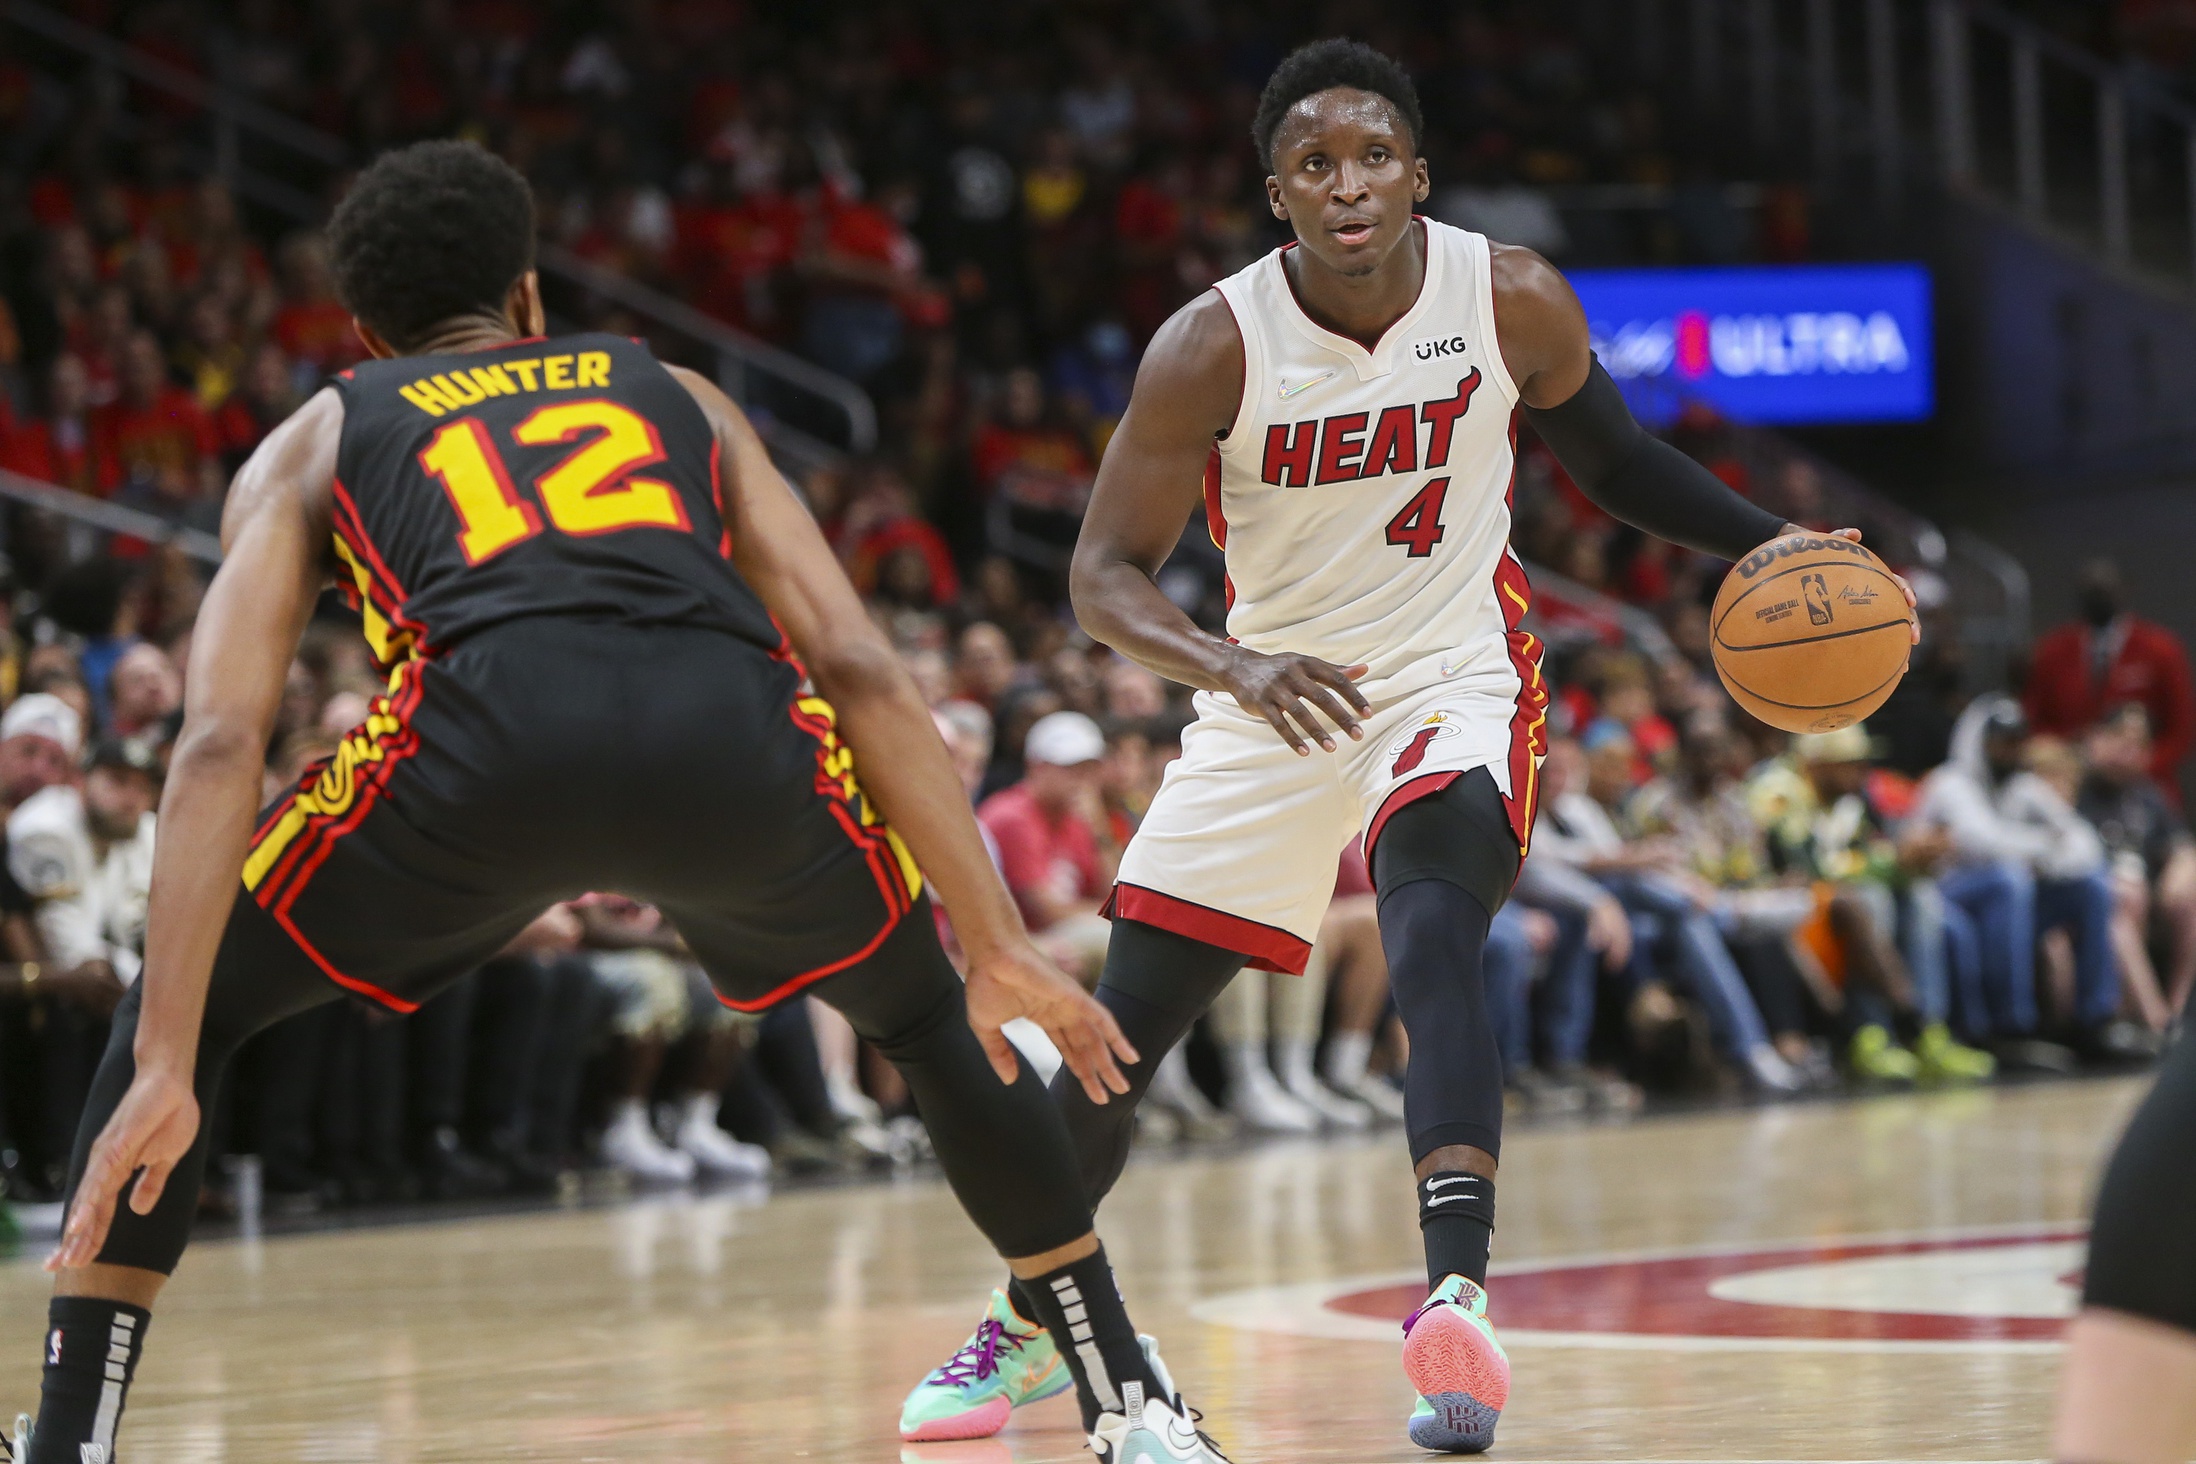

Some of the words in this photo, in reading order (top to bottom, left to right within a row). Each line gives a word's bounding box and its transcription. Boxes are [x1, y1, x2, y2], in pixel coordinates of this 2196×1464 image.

[1709, 312, 1909, 377] ULTRA
[399, 351, 611, 417] HUNTER
[1261, 365, 1482, 488] HEAT
[417, 397, 694, 567] 12
[1385, 476, 1451, 558] 4
[1736, 536, 1873, 580] Wilson
[1787, 599, 1799, 609] BALL
[1812, 613, 1827, 623] NBA
